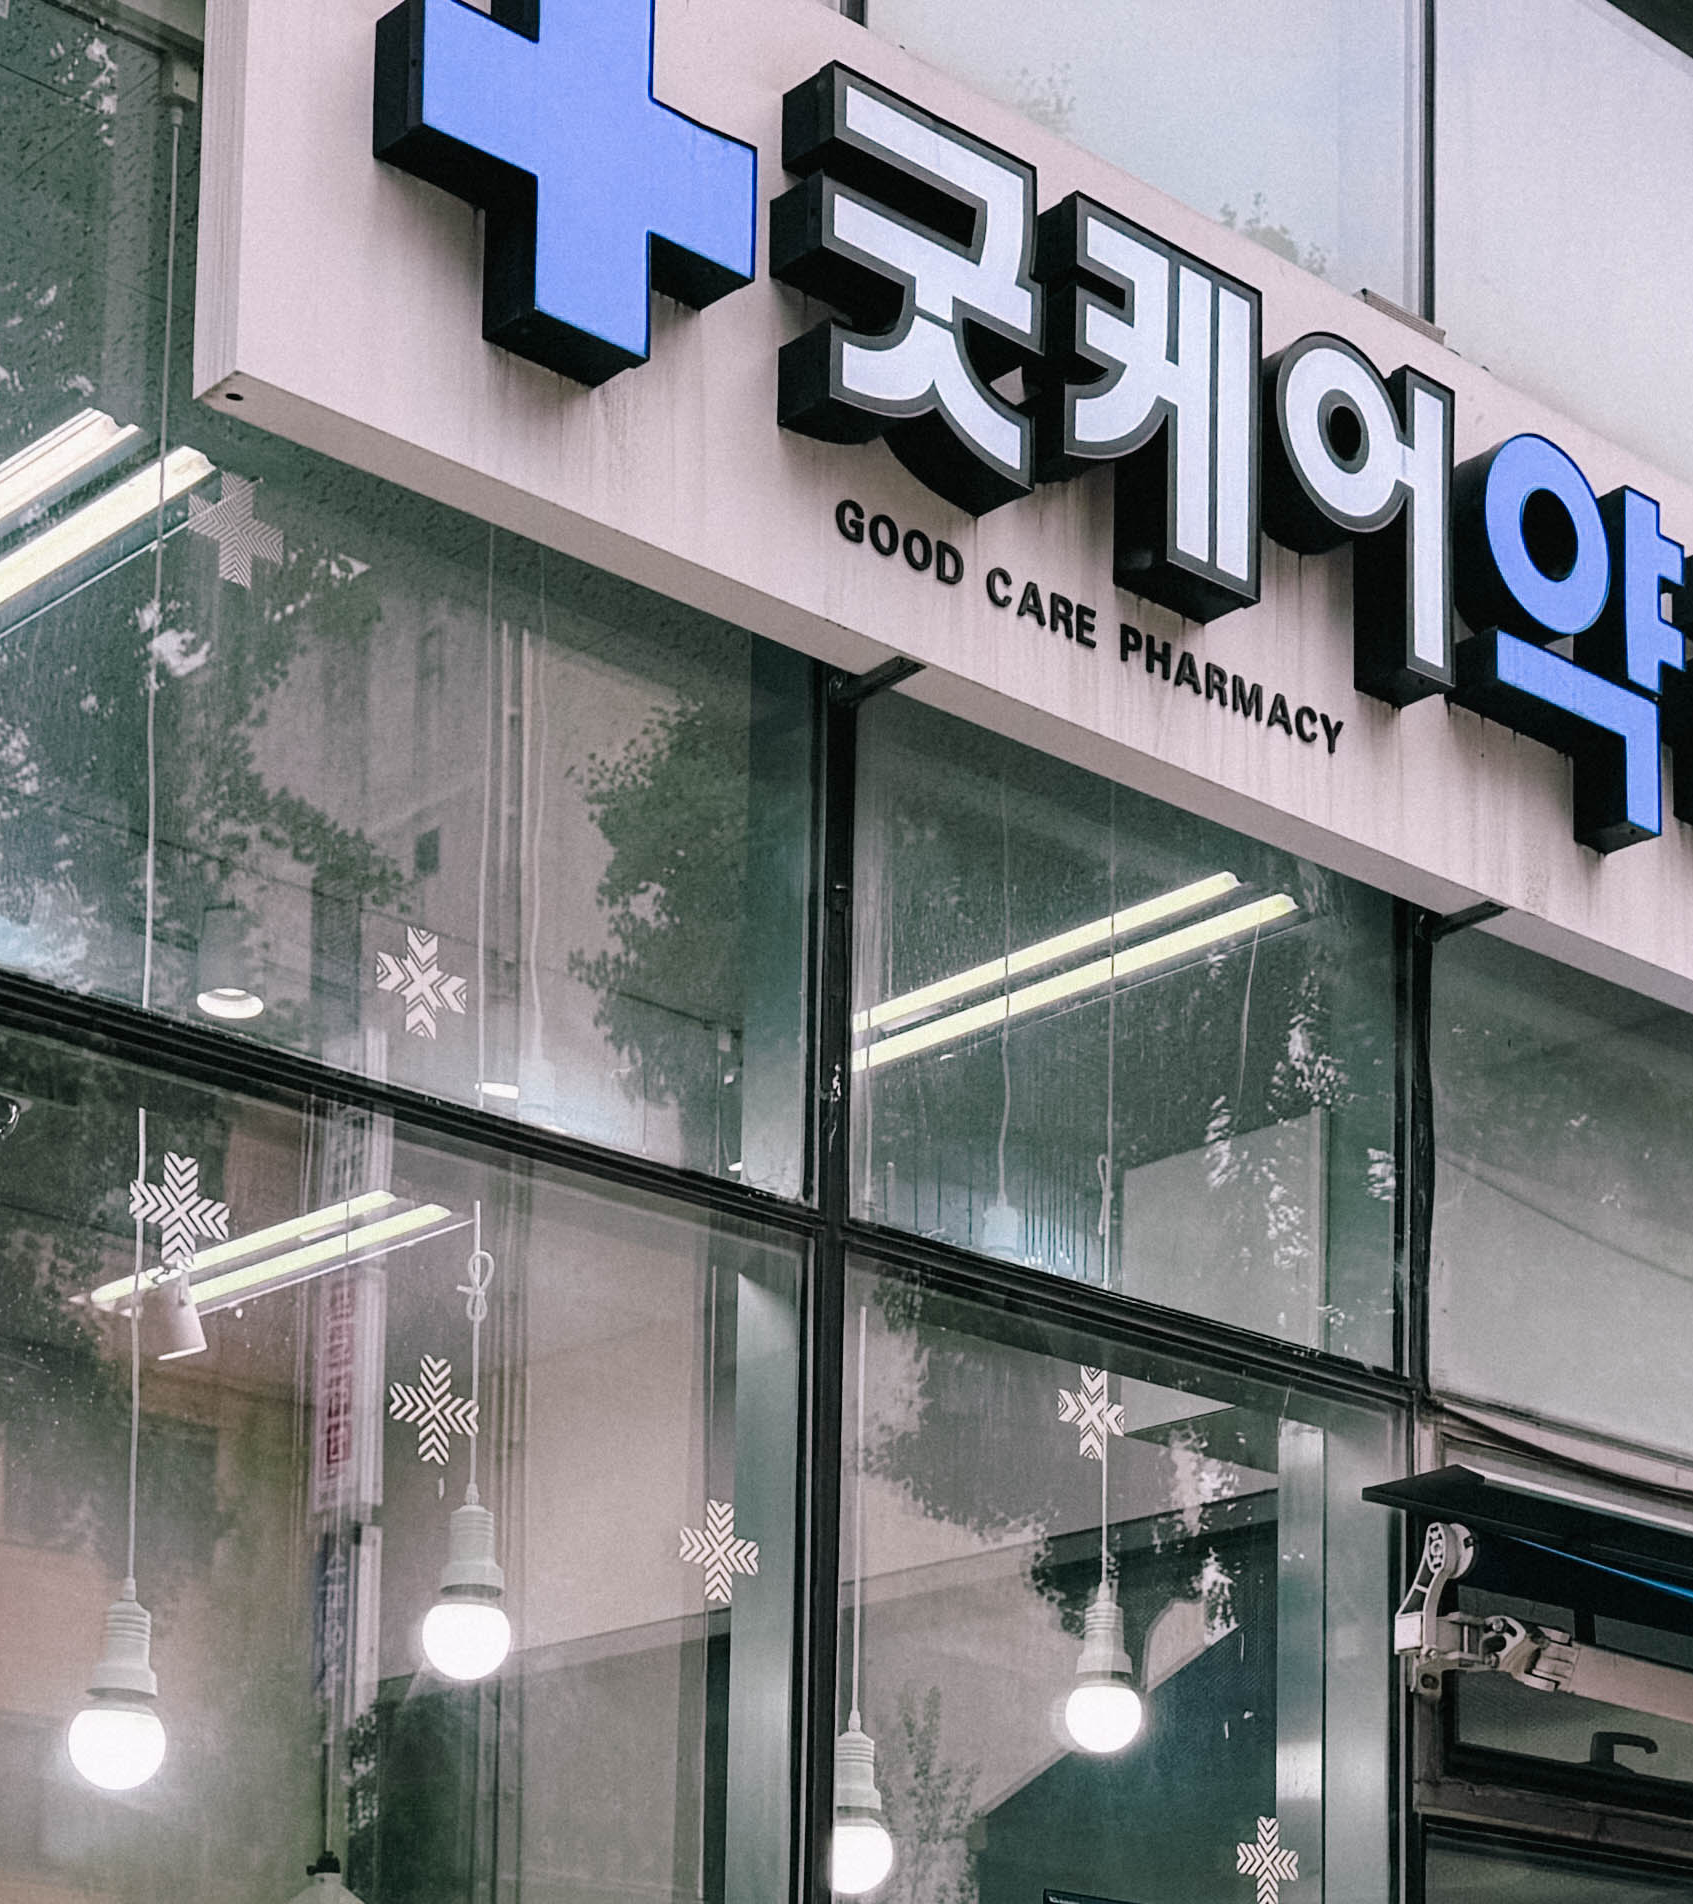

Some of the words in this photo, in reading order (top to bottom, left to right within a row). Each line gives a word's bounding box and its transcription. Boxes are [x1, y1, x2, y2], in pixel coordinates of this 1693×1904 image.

[834, 498, 965, 586] GOOD
[985, 565, 1098, 651] CARE
[1118, 627, 1345, 756] PHARMACY
